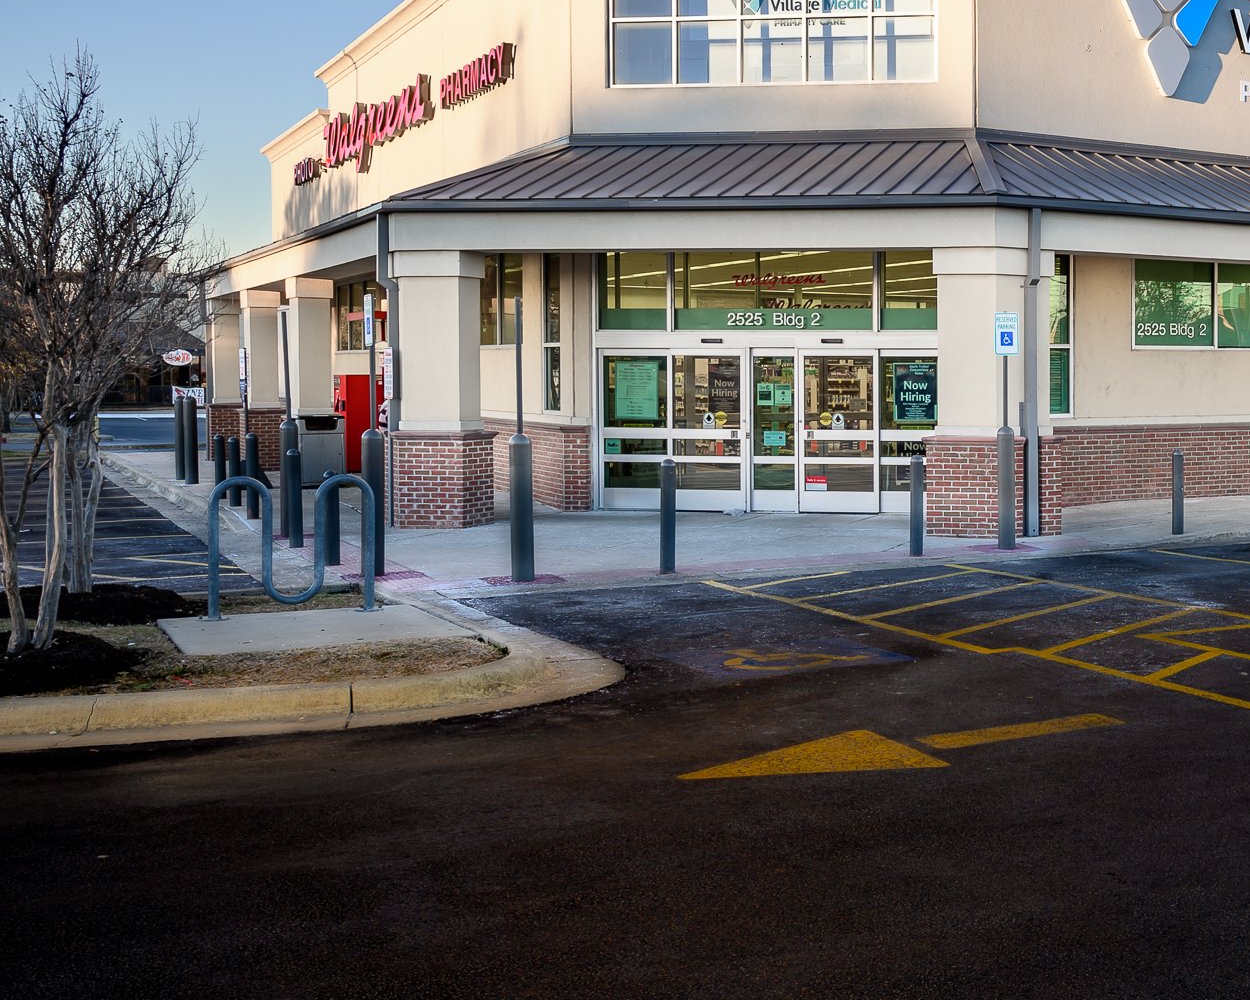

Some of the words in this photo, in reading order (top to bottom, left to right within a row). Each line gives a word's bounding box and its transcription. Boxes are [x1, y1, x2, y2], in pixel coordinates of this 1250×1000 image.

[323, 72, 430, 174] Walgreens
[439, 42, 511, 110] PHARMACY
[731, 272, 827, 290] Walgreens
[727, 312, 763, 326] 2525
[773, 312, 804, 328] Bldg
[811, 312, 821, 326] 2
[1137, 323, 1166, 336] 2525
[1169, 323, 1194, 339] Bldg
[1199, 323, 1207, 336] 2
[714, 379, 735, 388] Now
[903, 380, 928, 390] Now
[711, 389, 738, 399] Hiring
[900, 391, 931, 403] Hiring
